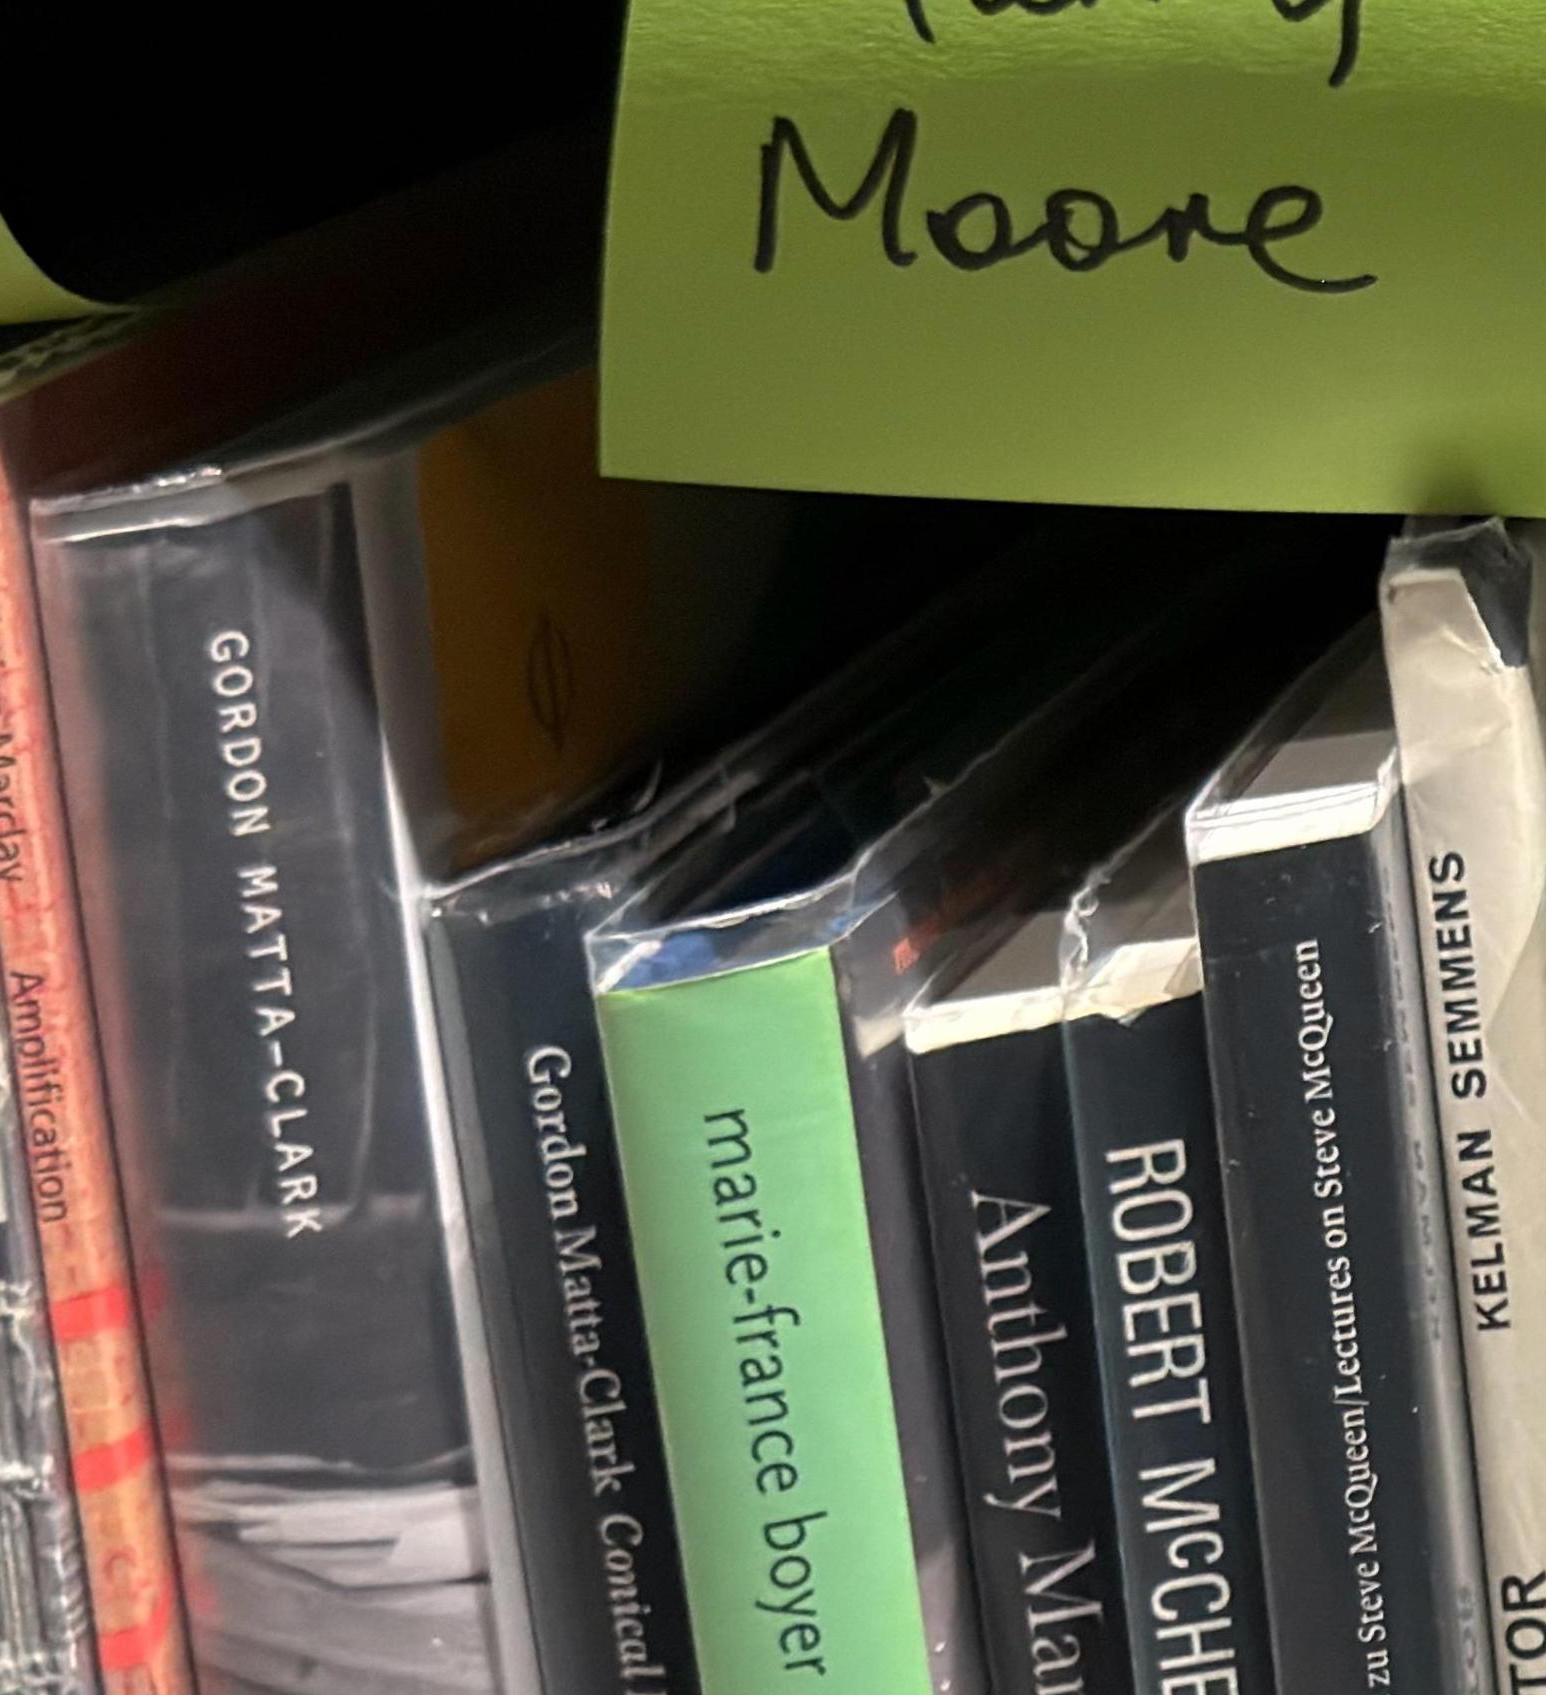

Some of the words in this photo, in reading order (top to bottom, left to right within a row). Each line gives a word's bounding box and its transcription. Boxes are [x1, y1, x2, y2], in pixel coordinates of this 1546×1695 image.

[752, 106, 1378, 295] Moore
[210, 630, 270, 837] GORDON
[237, 864, 322, 1238] MATTA-CLARK
[1298, 938, 1334, 1104] McQueen
[1429, 850, 1489, 1099] SEMMENS
[10, 970, 75, 1224] Amplification
[527, 1045, 588, 1220] Gordon
[1310, 1107, 1343, 1199] Steve
[1105, 1137, 1213, 1425] ROBERT
[1323, 1205, 1347, 1248] on
[1454, 1129, 1512, 1331] KELMAN
[555, 1226, 636, 1497] Matta-Clark
[704, 1108, 801, 1495] marie-france
[756, 1511, 828, 1676] boyer
[970, 1190, 1068, 1520] Anthony
[599, 1514, 667, 1680] Conical
[1358, 1561, 1387, 1643] Steve
[1368, 1642, 1393, 1689] zu
